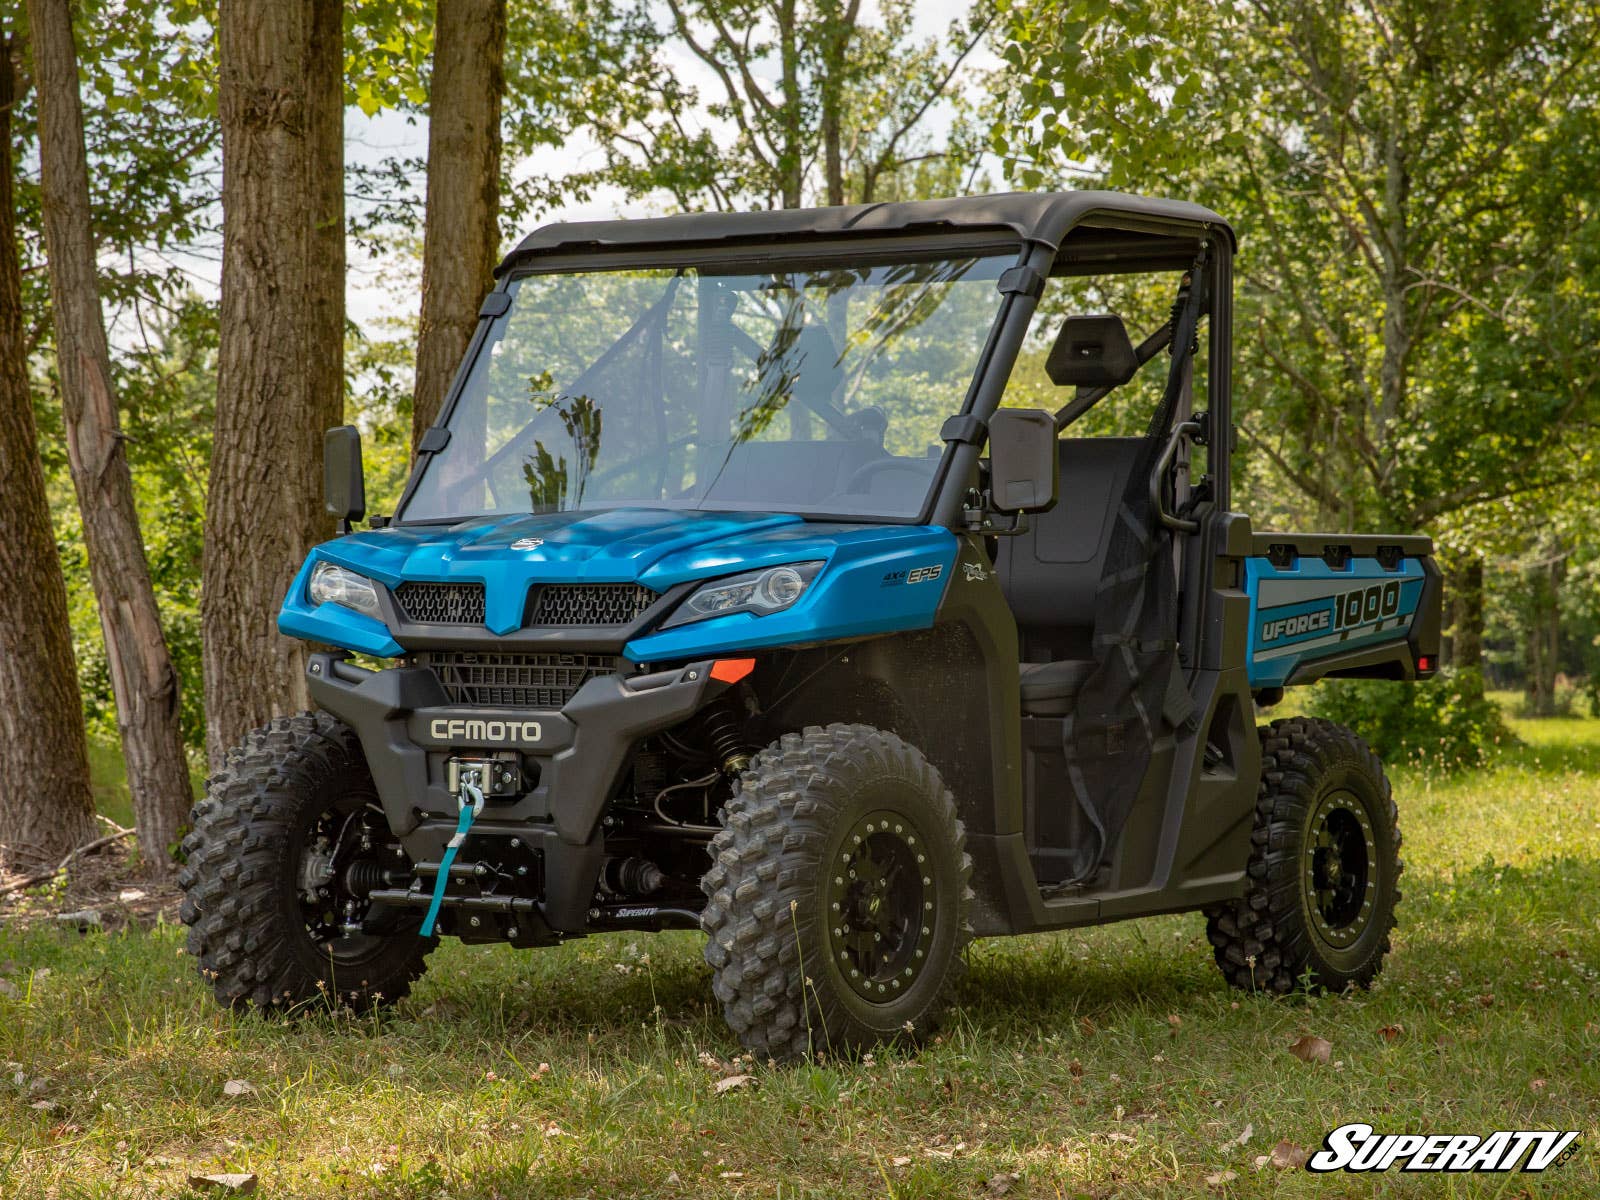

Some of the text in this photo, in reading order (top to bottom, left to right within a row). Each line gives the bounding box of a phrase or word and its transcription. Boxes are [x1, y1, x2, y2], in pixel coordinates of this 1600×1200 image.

[907, 564, 943, 584] EPS
[1262, 579, 1401, 642] UFORCE 1000
[430, 719, 542, 742] CFMOTO
